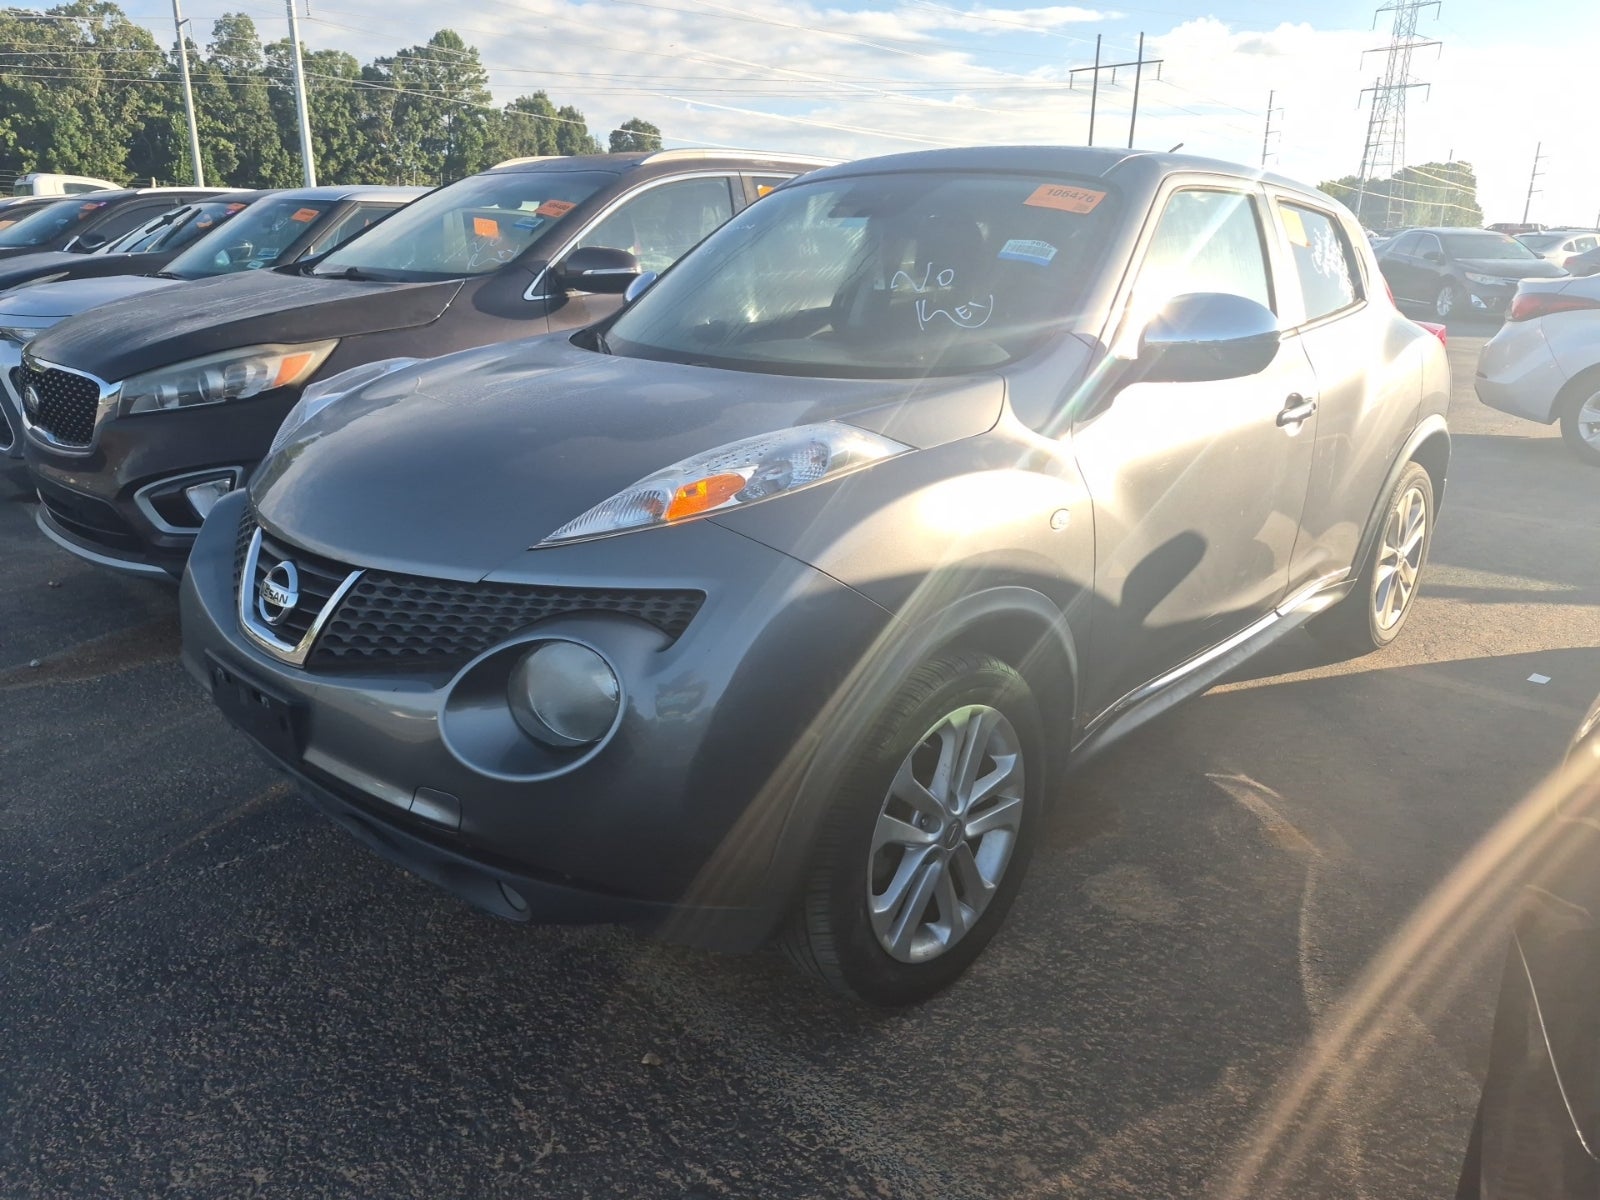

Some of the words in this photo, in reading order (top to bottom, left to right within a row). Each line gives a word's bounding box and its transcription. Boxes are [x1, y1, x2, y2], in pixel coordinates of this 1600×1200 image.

[1047, 188, 1097, 203] 106476
[890, 261, 955, 293] NO
[915, 294, 994, 331] KEY
[263, 581, 289, 605] SSAN
